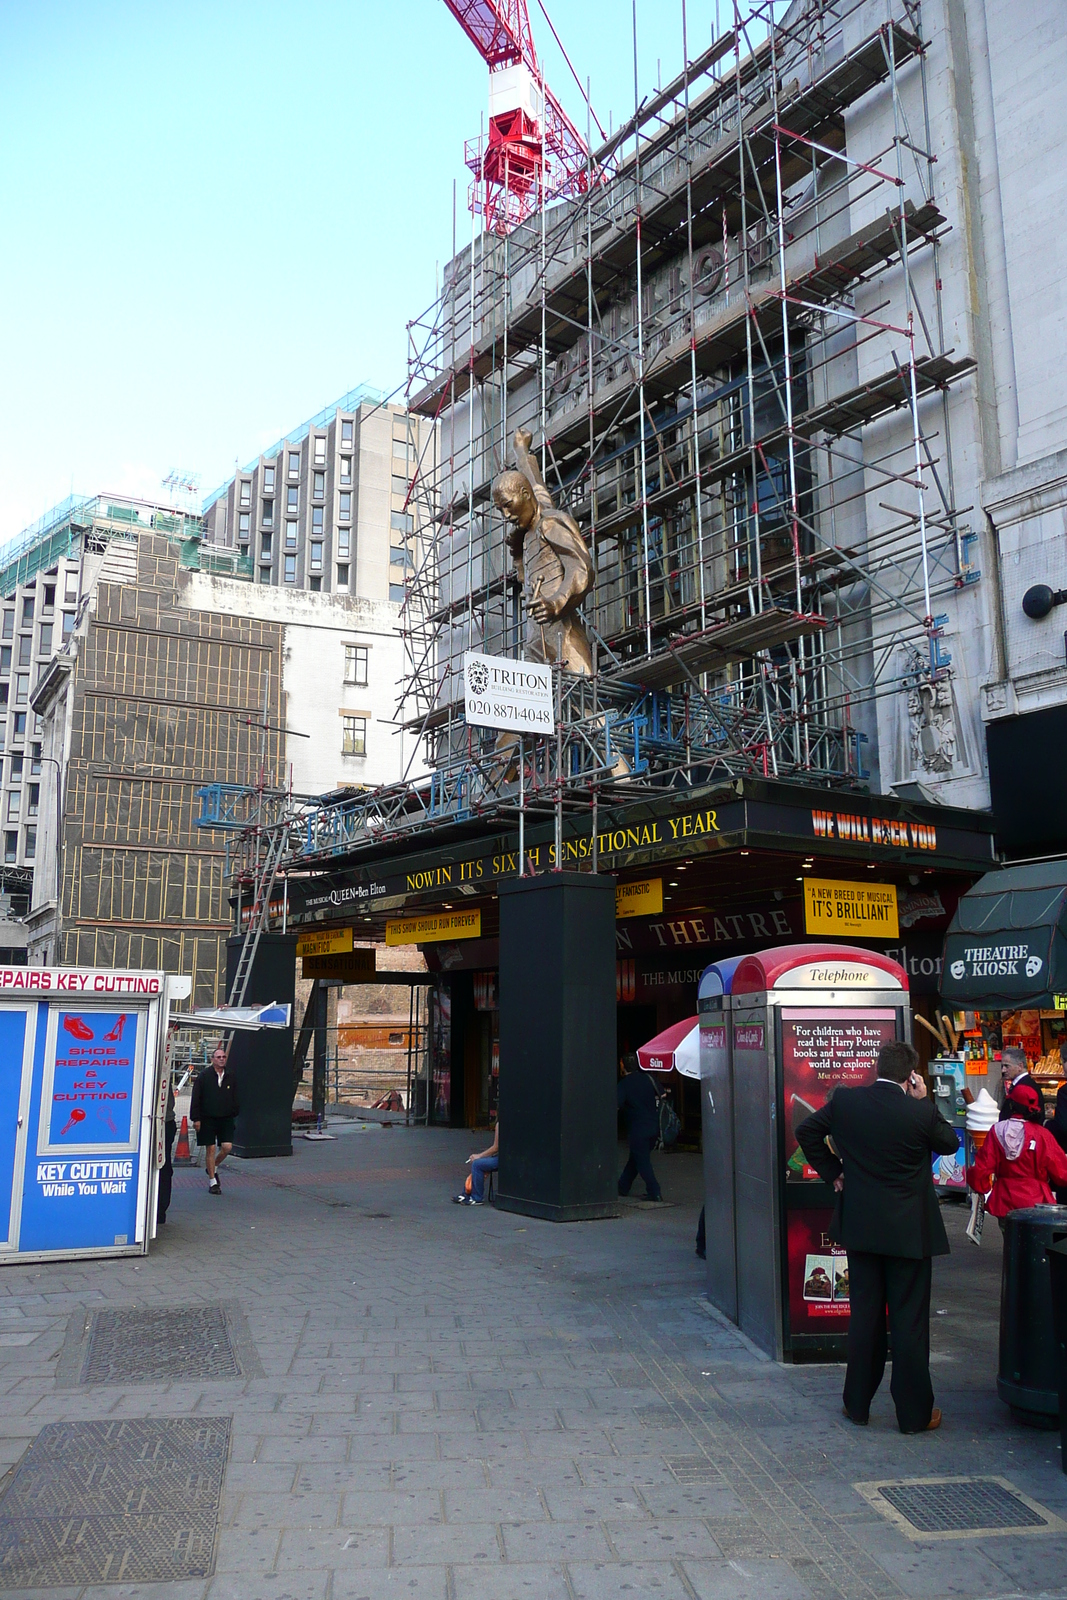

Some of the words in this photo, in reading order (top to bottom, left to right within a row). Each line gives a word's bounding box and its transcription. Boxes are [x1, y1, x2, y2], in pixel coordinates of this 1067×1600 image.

[491, 668, 548, 690] TRITON
[491, 684, 515, 693] BUILDING
[515, 688, 549, 698] RESTORATION
[468, 699, 491, 716] 020
[493, 703, 518, 719] 8871
[520, 708, 550, 723] 4048
[811, 810, 835, 838] WE
[836, 813, 871, 842] WILL
[872, 817, 909, 847] ROCK
[909, 823, 937, 850] YOU
[406, 870, 435, 891] NOW
[436, 865, 452, 885] IN
[459, 859, 484, 881] ITS
[548, 823, 662, 864] SENSATIONAL
[668, 810, 720, 840] YEAR
[330, 888, 355, 905] QUEEN
[622, 883, 650, 897] FANTASTIC
[818, 888, 832, 899] NEW
[834, 889, 855, 900] BREED
[857, 891, 865, 901] OF
[867, 892, 894, 903] MUSICAL
[813, 900, 833, 917] IT'S
[402, 921, 417, 934] SHOW
[417, 920, 438, 932] SHOULD
[439, 918, 450, 930] RUN
[649, 910, 793, 946] THEATRE
[964, 945, 1029, 962] THEATRE
[810, 968, 870, 983] Telephone
[972, 960, 1019, 977] KIOSK
[56, 973, 89, 990] KEY
[94, 975, 159, 993] CUTTING
[642, 970, 665, 986] THE
[812, 1026, 844, 1036] children
[845, 1026, 862, 1036] who
[864, 1026, 881, 1036] have
[797, 1037, 814, 1047] read
[816, 1037, 828, 1047] the
[831, 1037, 854, 1049] Harry
[856, 1037, 881, 1047] Potter
[793, 1048, 818, 1057] books
[819, 1048, 834, 1057] and
[836, 1049, 854, 1057] want
[856, 1048, 879, 1057] anoth
[55, 1058, 130, 1067] REPAIRS
[808, 1059, 830, 1068] world
[832, 1060, 841, 1068] to
[73, 1081, 108, 1089] KEY
[53, 1092, 128, 1101] CUTTING
[37, 1164, 67, 1180] KEY
[70, 1161, 133, 1180] CUTTING
[42, 1183, 75, 1197] While
[77, 1182, 98, 1195] You
[101, 1181, 127, 1194] Wait
